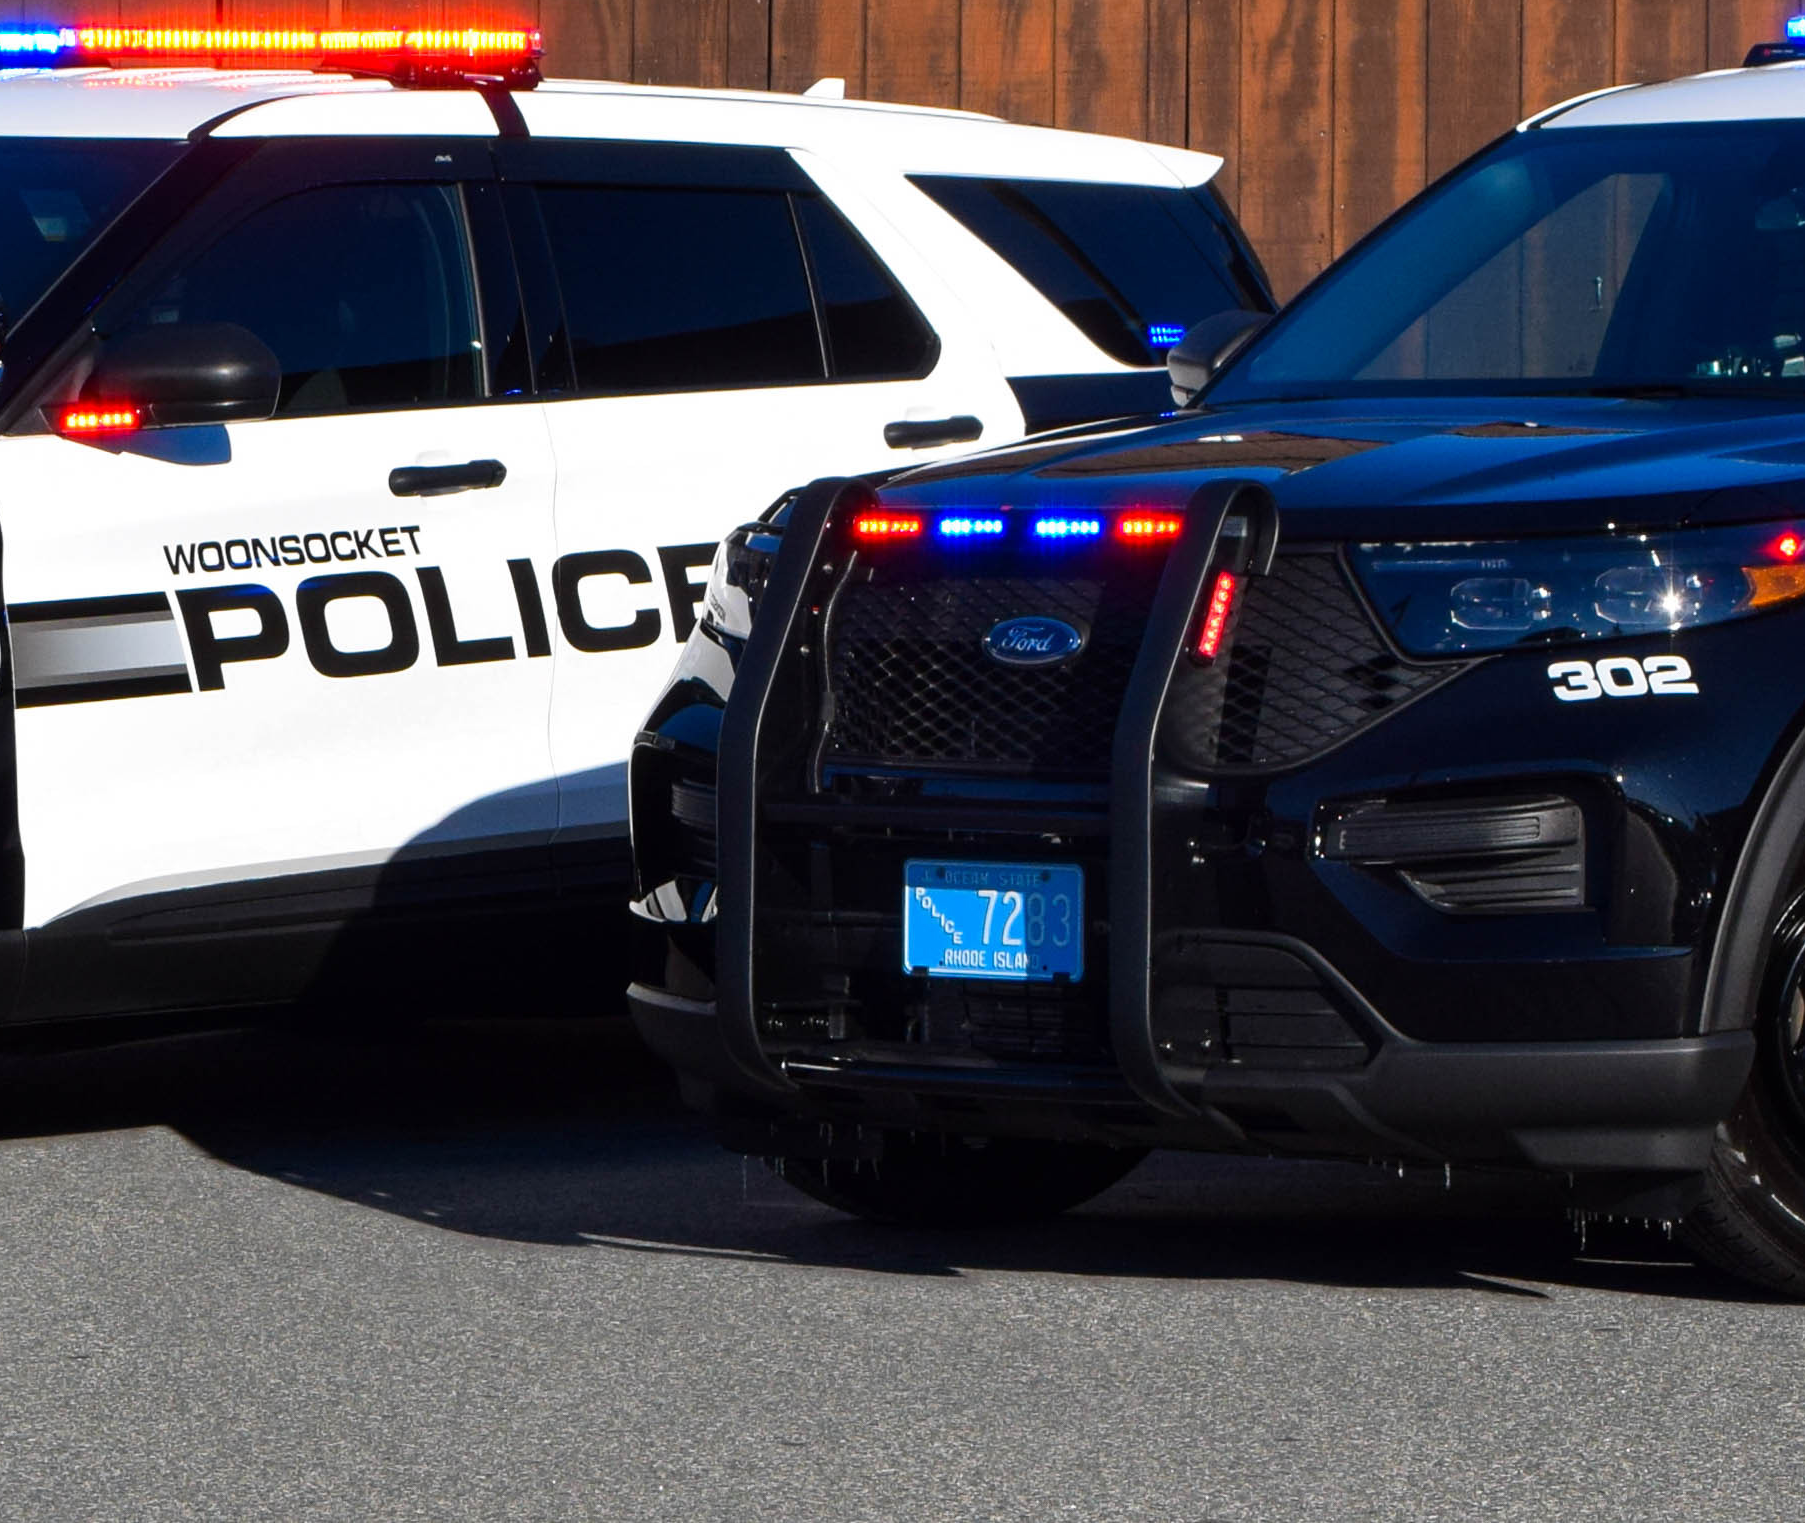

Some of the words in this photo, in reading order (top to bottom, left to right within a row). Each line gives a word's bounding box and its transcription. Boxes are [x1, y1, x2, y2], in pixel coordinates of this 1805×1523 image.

[163, 525, 421, 575] WOONSOCKET
[174, 541, 721, 693] POLICE
[1001, 625, 1055, 652] Ford
[1547, 655, 1700, 701] 302
[944, 870, 989, 886] OCEAN
[999, 872, 1042, 887] STATE
[915, 886, 963, 944] POLICE
[977, 889, 1071, 947] 7283
[945, 949, 986, 968] RHODE
[993, 951, 1040, 970] ISLAND
